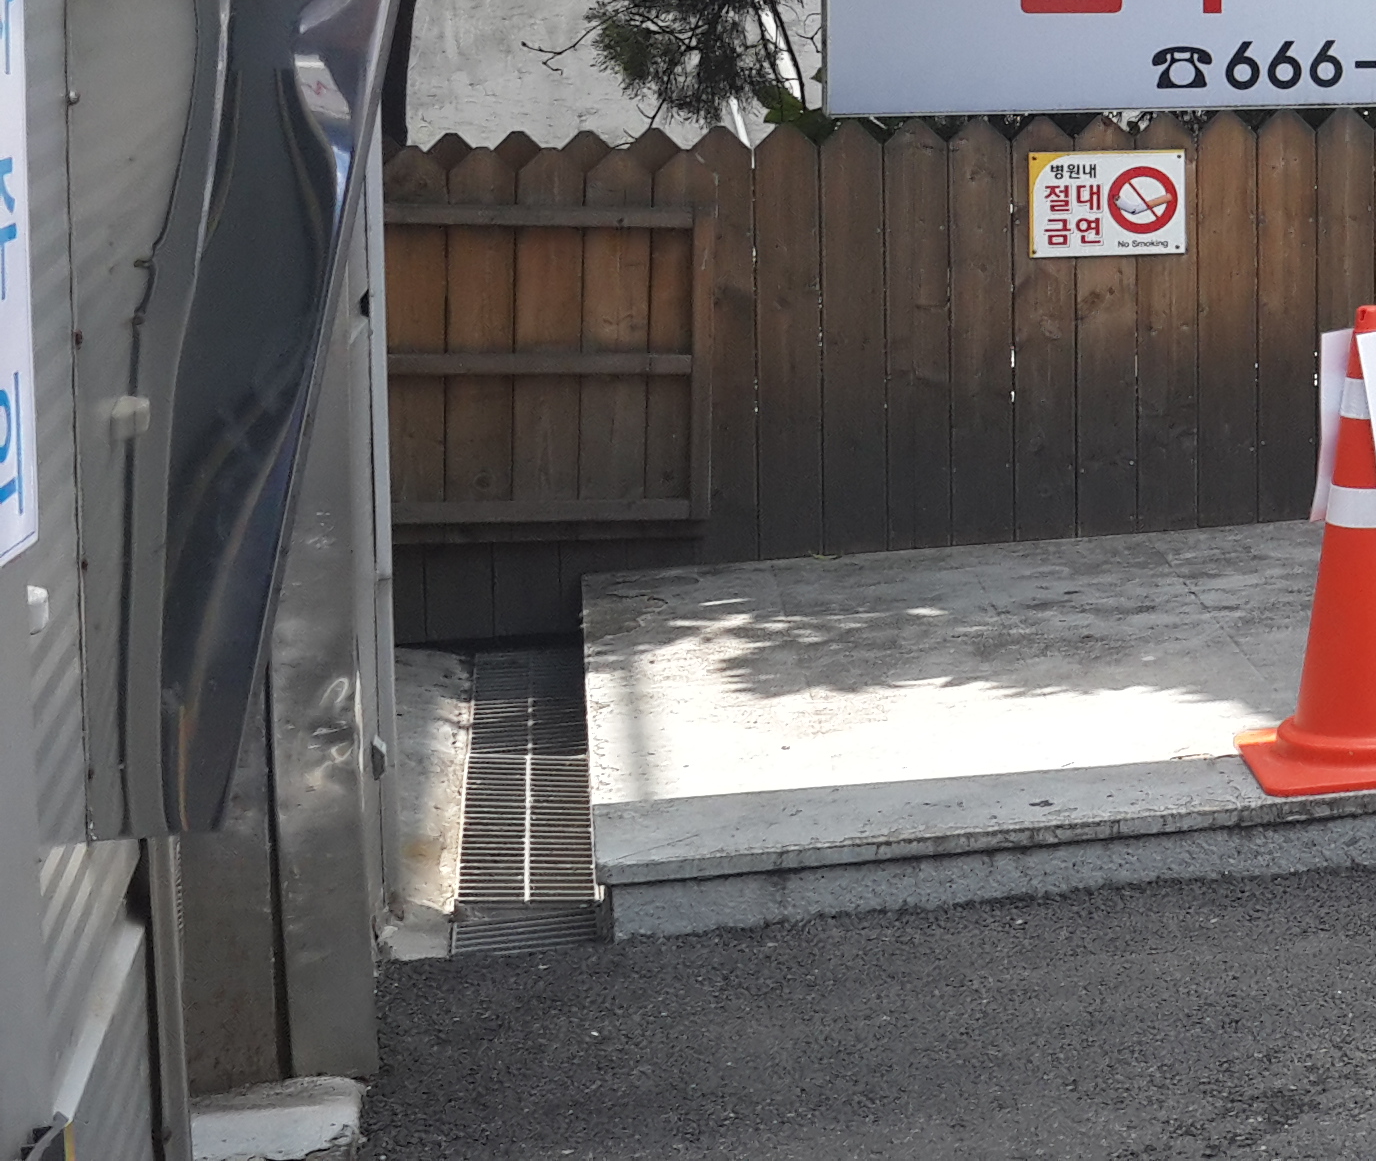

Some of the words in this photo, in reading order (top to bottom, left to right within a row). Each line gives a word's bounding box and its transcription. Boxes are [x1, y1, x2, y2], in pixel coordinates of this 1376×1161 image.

[1050, 164, 1097, 180] 병원내
[1044, 184, 1101, 213] 절대
[1044, 217, 1101, 246] 금연
[1117, 240, 1129, 248] No
[1132, 239, 1168, 248] Smoking
